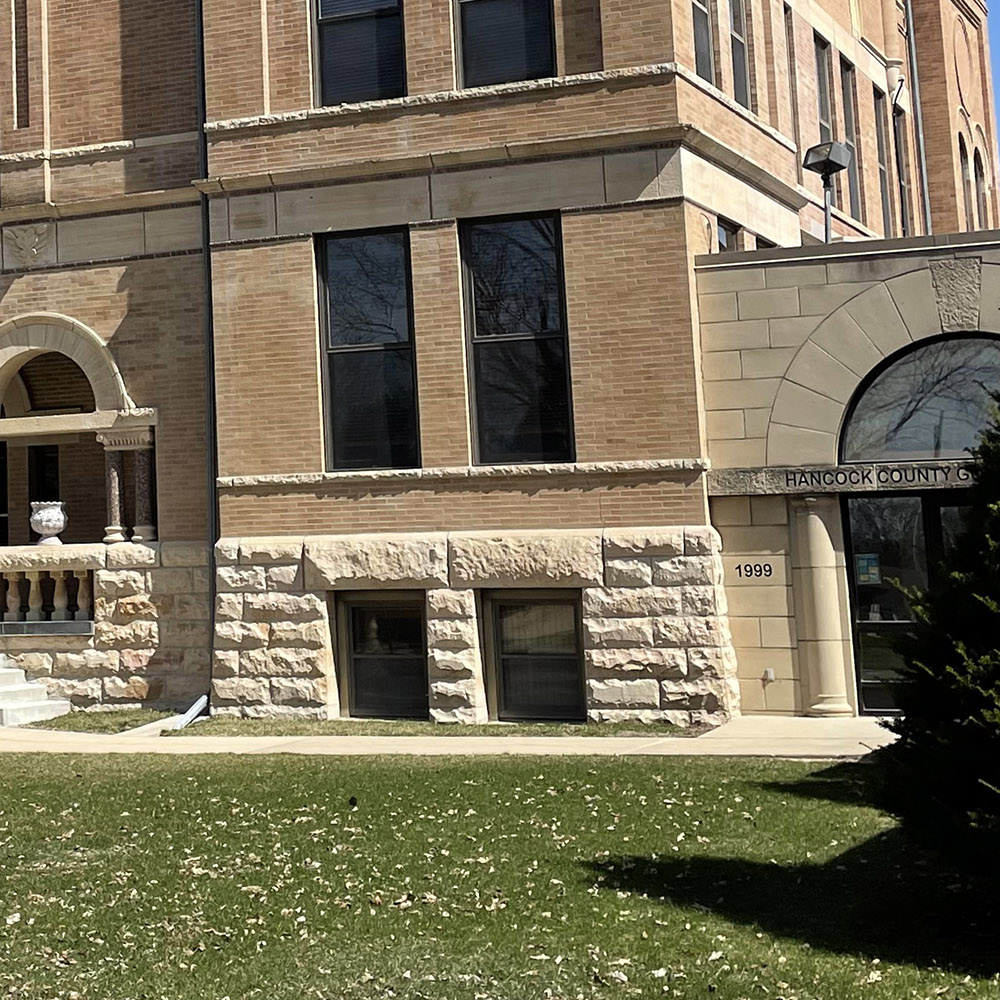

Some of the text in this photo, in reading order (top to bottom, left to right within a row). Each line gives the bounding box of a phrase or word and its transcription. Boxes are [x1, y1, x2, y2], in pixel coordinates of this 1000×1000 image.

[785, 469, 873, 488] HANCOCK
[877, 467, 951, 484] COUNTY
[734, 563, 773, 578] 1999
